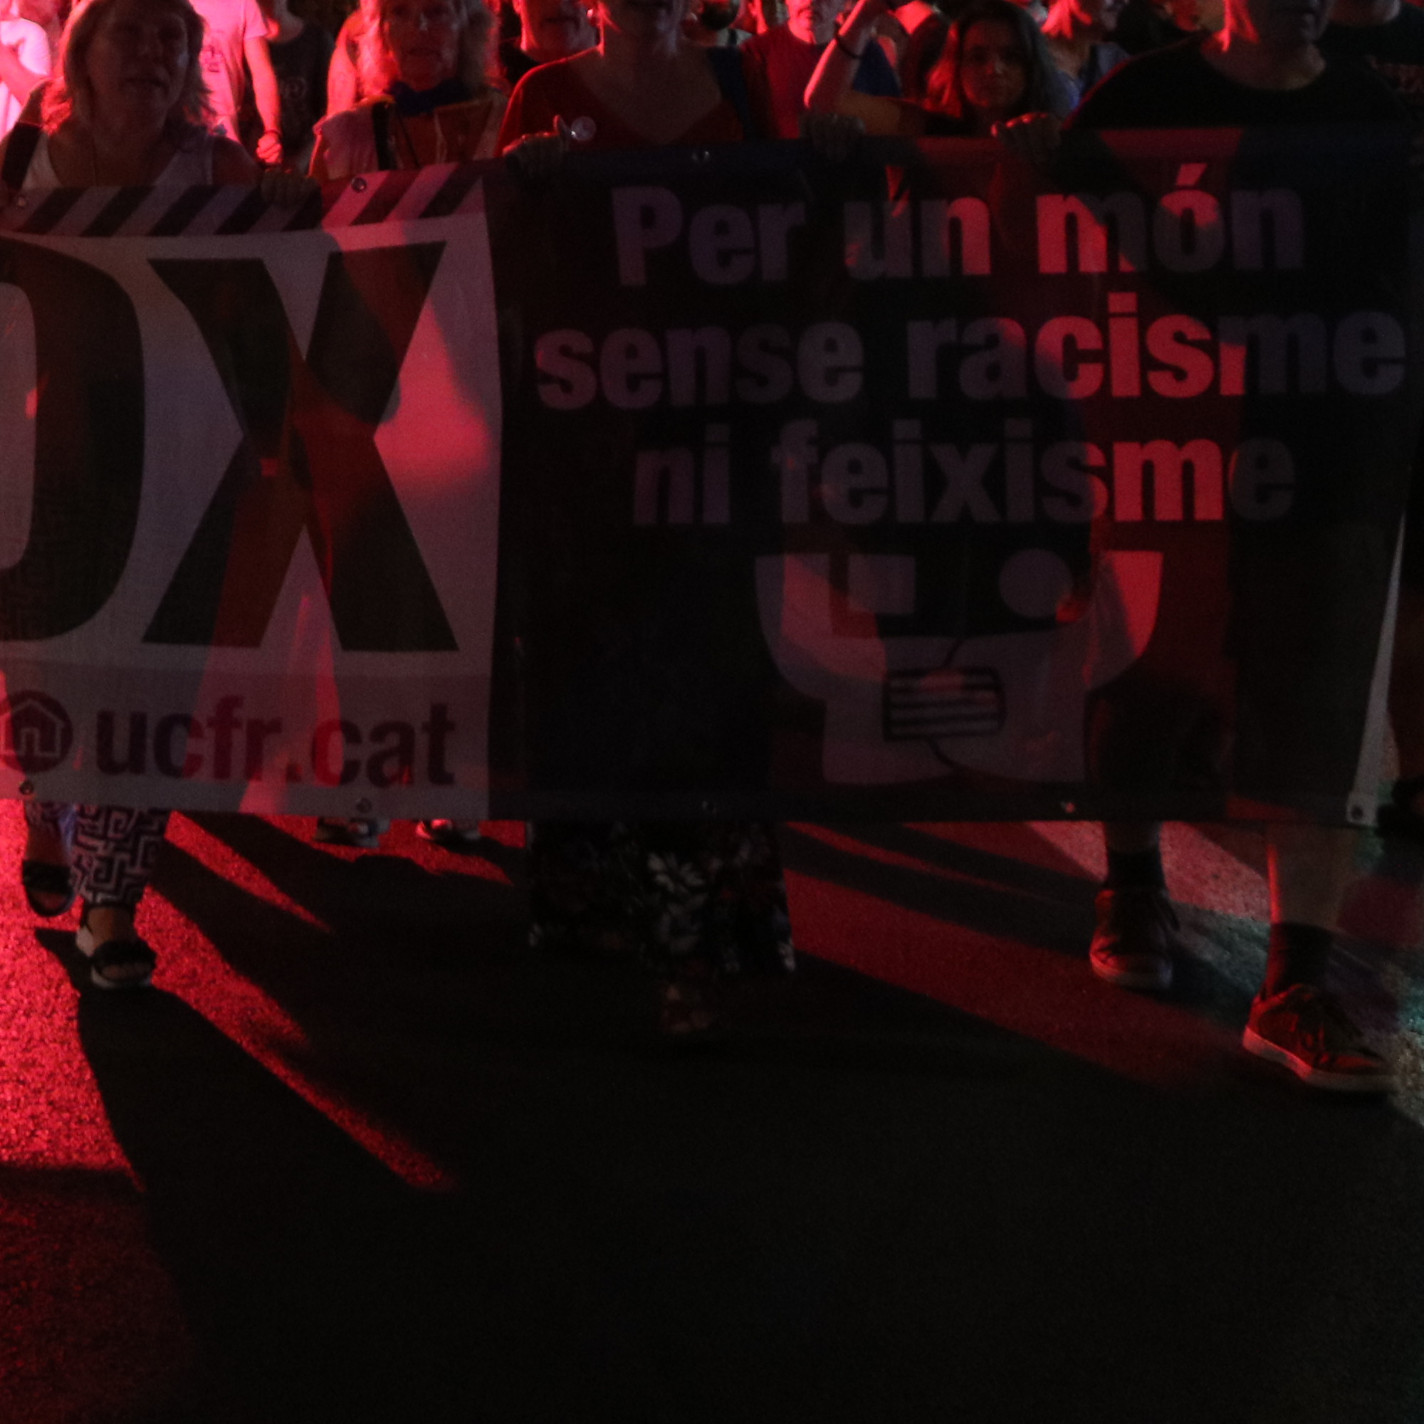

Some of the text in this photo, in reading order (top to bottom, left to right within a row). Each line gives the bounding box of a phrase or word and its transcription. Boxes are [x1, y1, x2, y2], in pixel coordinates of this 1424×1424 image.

[609, 163, 1305, 289] Per un món
[534, 291, 1407, 411] sense racisme
[631, 417, 1297, 528] ni feixisme
